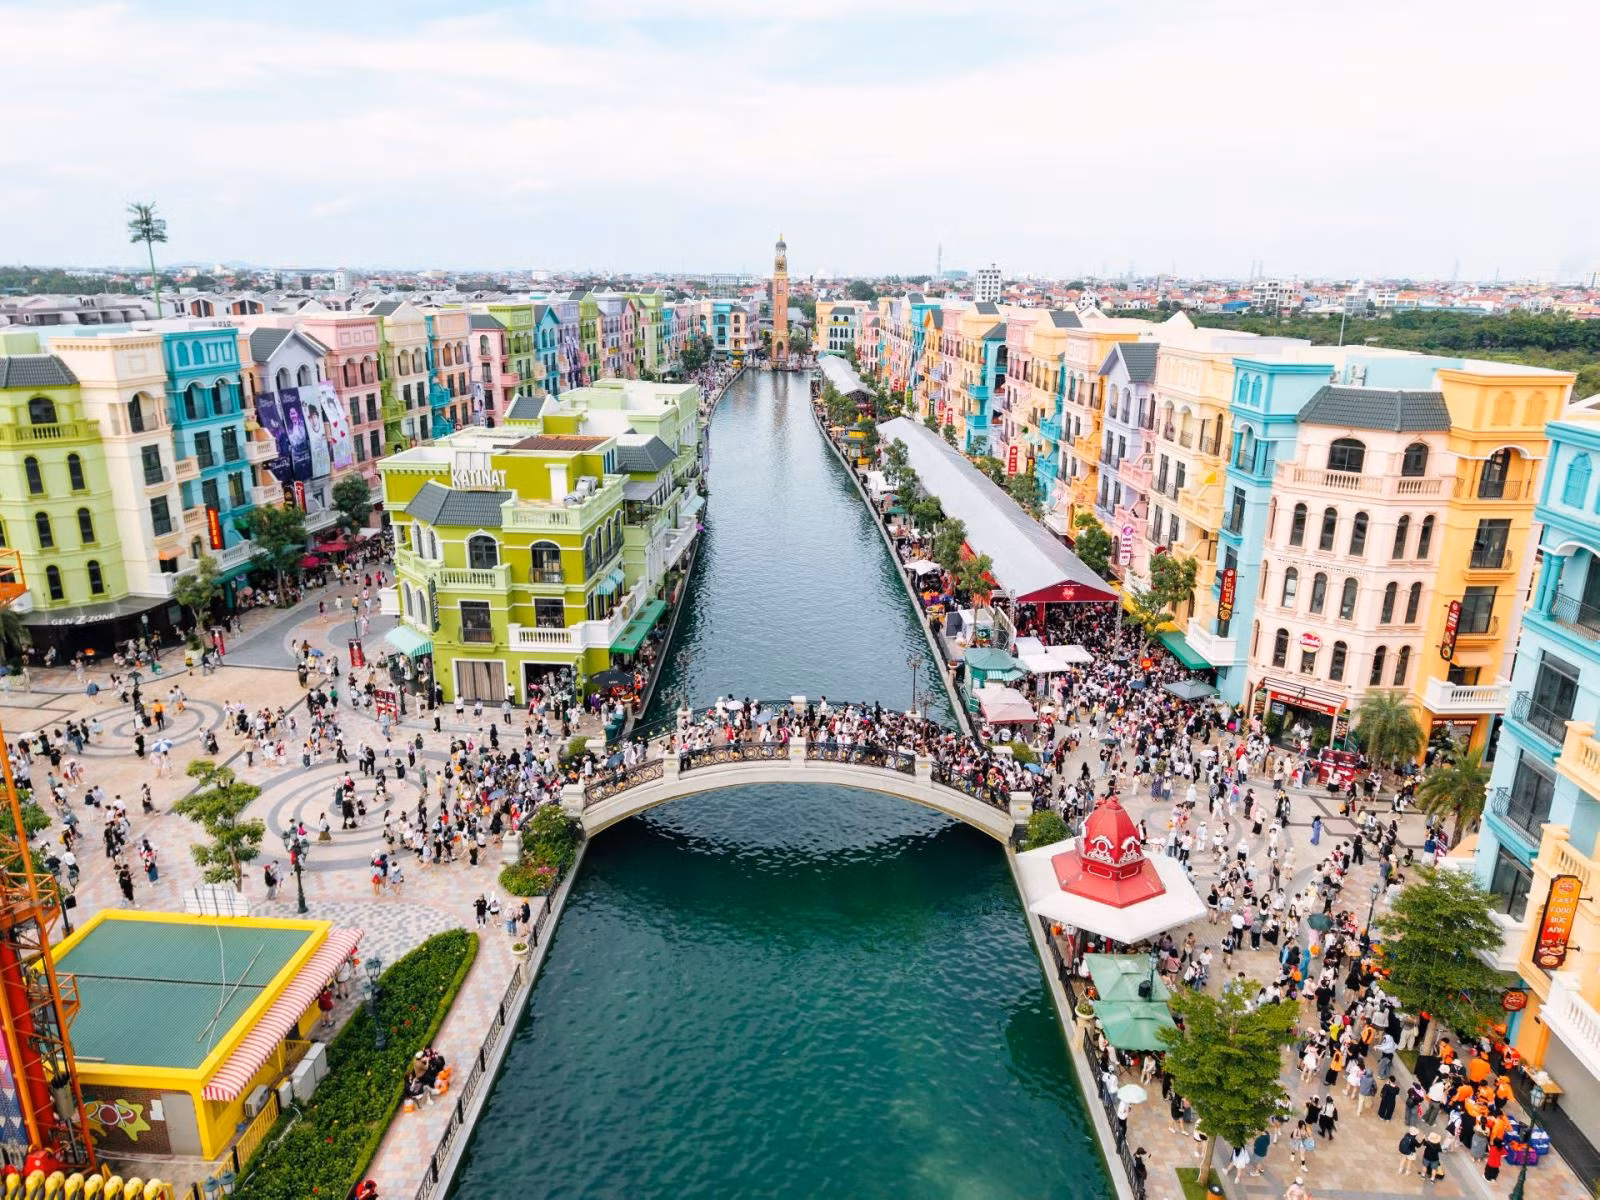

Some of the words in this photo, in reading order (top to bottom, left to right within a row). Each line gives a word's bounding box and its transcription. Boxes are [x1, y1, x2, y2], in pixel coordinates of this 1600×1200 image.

[453, 469, 506, 487] KATINAT
[50, 618, 73, 626] GEN
[74, 615, 87, 625] Z
[88, 613, 116, 623] ZONE
